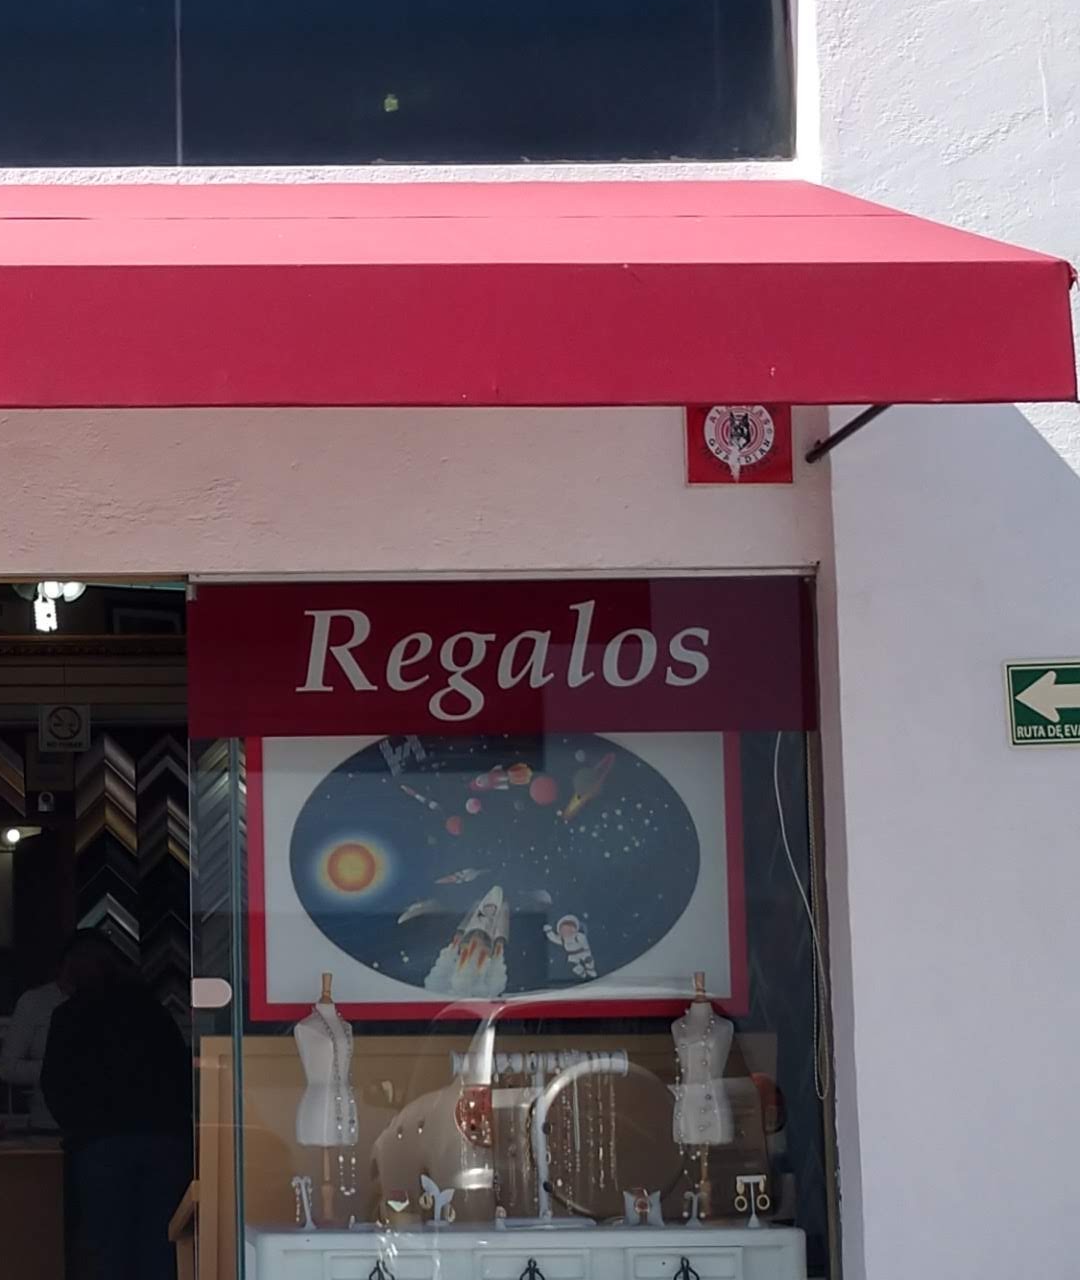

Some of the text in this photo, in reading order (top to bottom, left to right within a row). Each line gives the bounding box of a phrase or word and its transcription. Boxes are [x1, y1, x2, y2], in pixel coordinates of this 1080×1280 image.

[295, 599, 711, 721] Regalos
[1017, 725, 1047, 738] RUTA
[1047, 724, 1063, 738] DE
